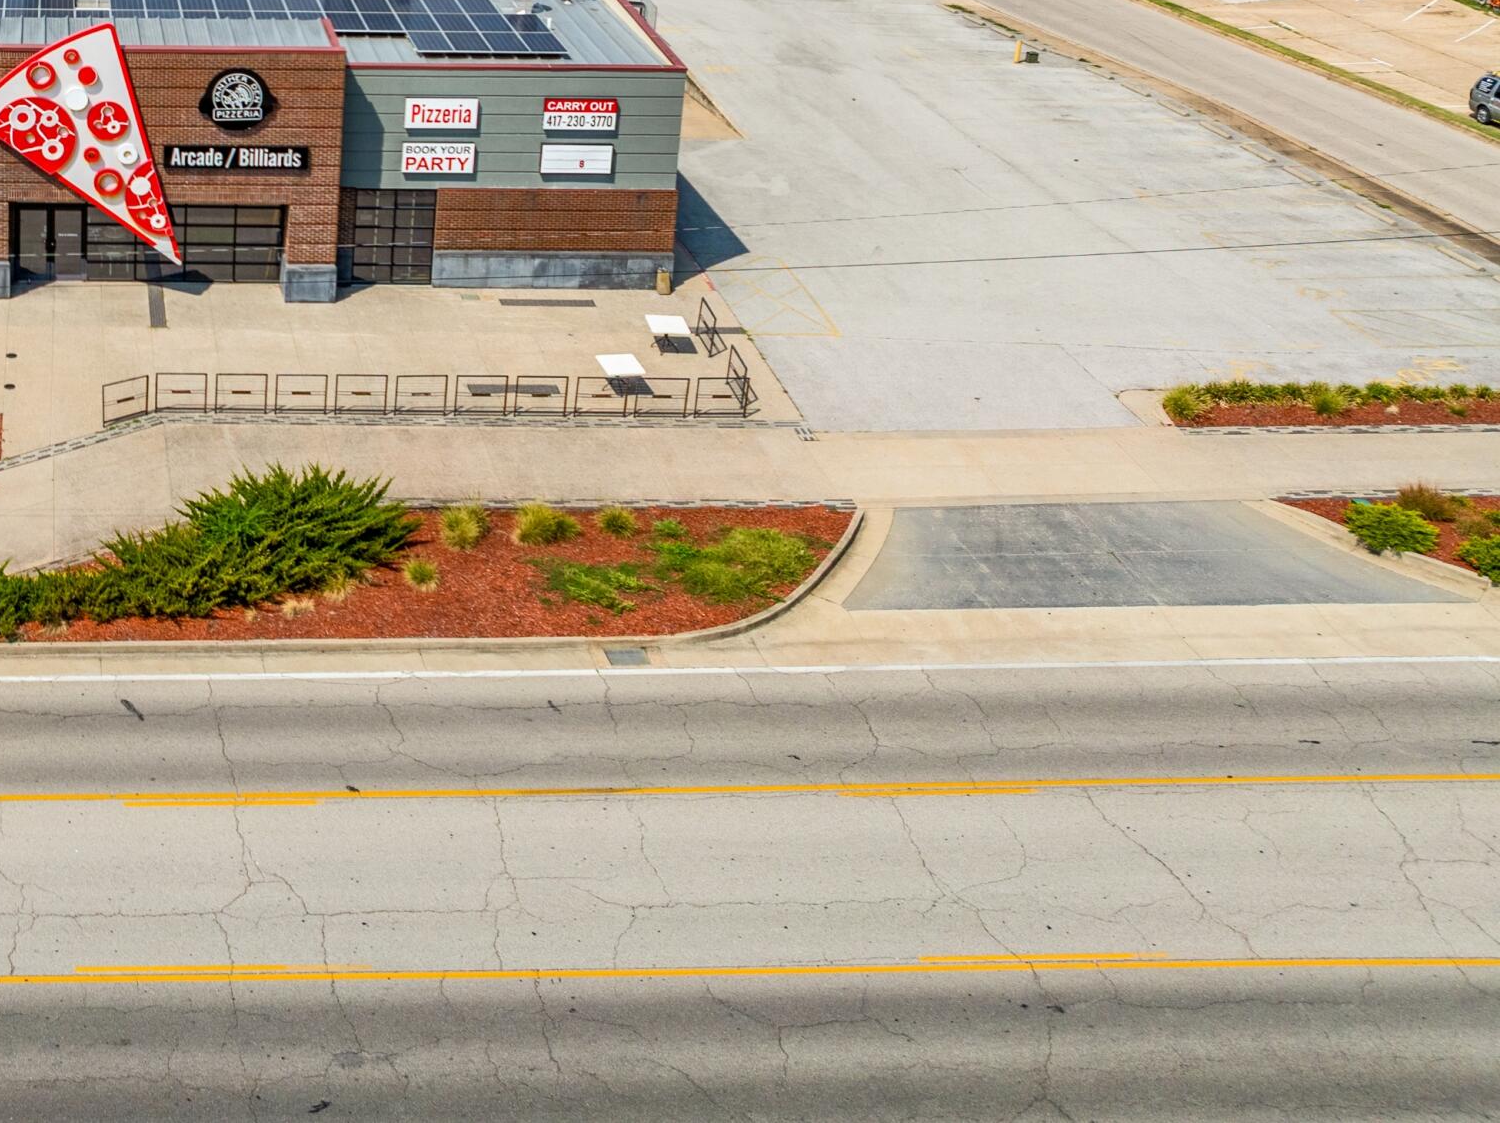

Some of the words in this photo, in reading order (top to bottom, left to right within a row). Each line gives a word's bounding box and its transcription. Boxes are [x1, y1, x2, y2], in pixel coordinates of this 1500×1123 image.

[215, 75, 248, 103] PANTHER
[251, 83, 261, 104] DEN
[547, 101, 588, 111] CARRY
[589, 102, 615, 112] OUT
[215, 110, 260, 118] PIZZERIA
[411, 104, 472, 124] Pizzeria
[546, 115, 613, 127] 417-230-3770
[405, 146, 438, 155] BOOK
[440, 146, 471, 155] YOUR
[170, 147, 223, 166] Arcade
[225, 147, 236, 168] /
[238, 148, 302, 168] Billiards
[405, 157, 469, 171] PARTY
